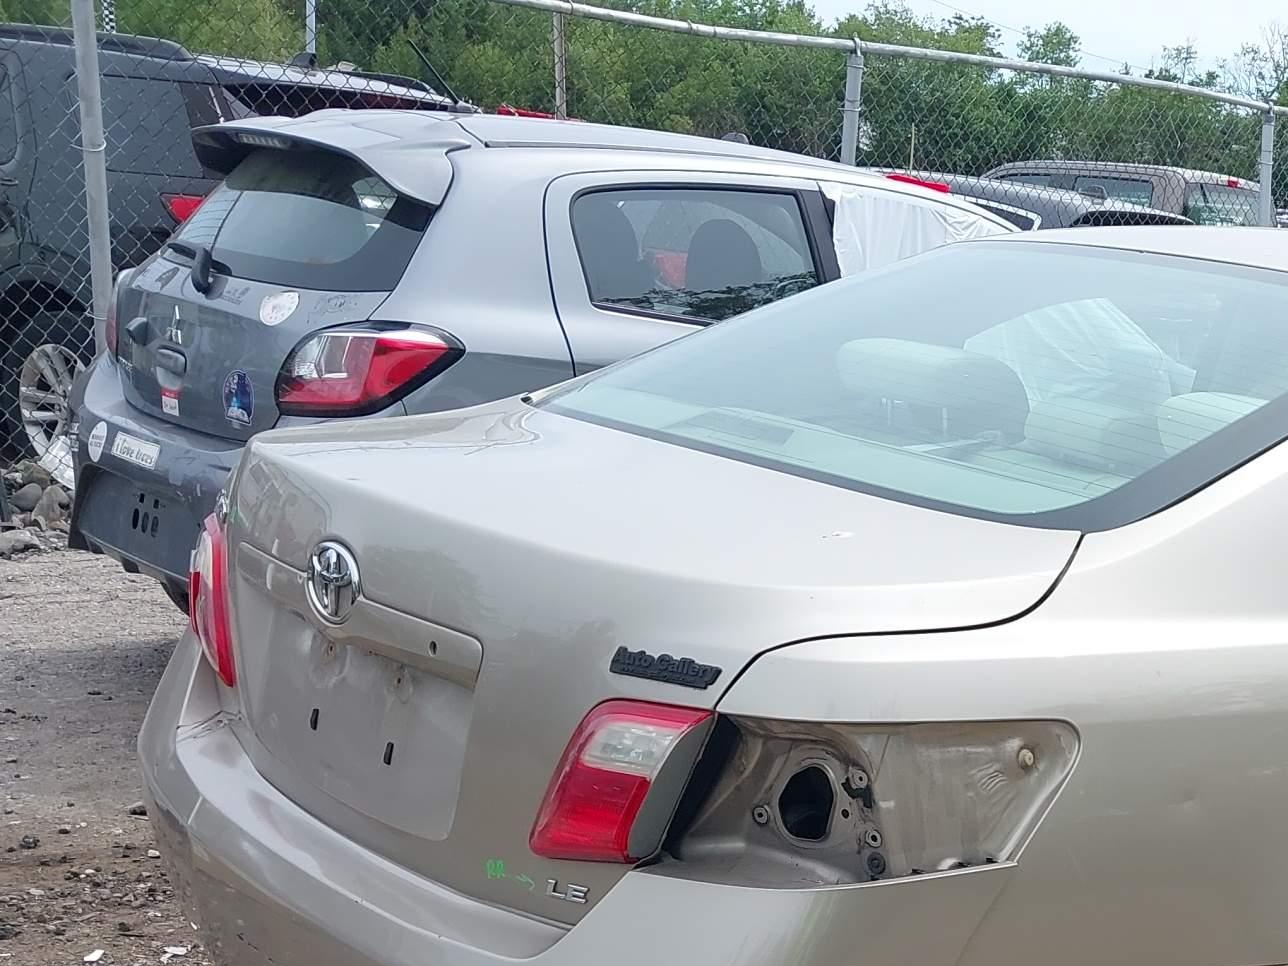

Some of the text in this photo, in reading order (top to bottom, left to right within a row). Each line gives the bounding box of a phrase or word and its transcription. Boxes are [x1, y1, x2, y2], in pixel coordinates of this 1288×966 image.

[611, 647, 655, 668] Auto
[657, 653, 722, 685] Gallery
[546, 879, 590, 904] LE
